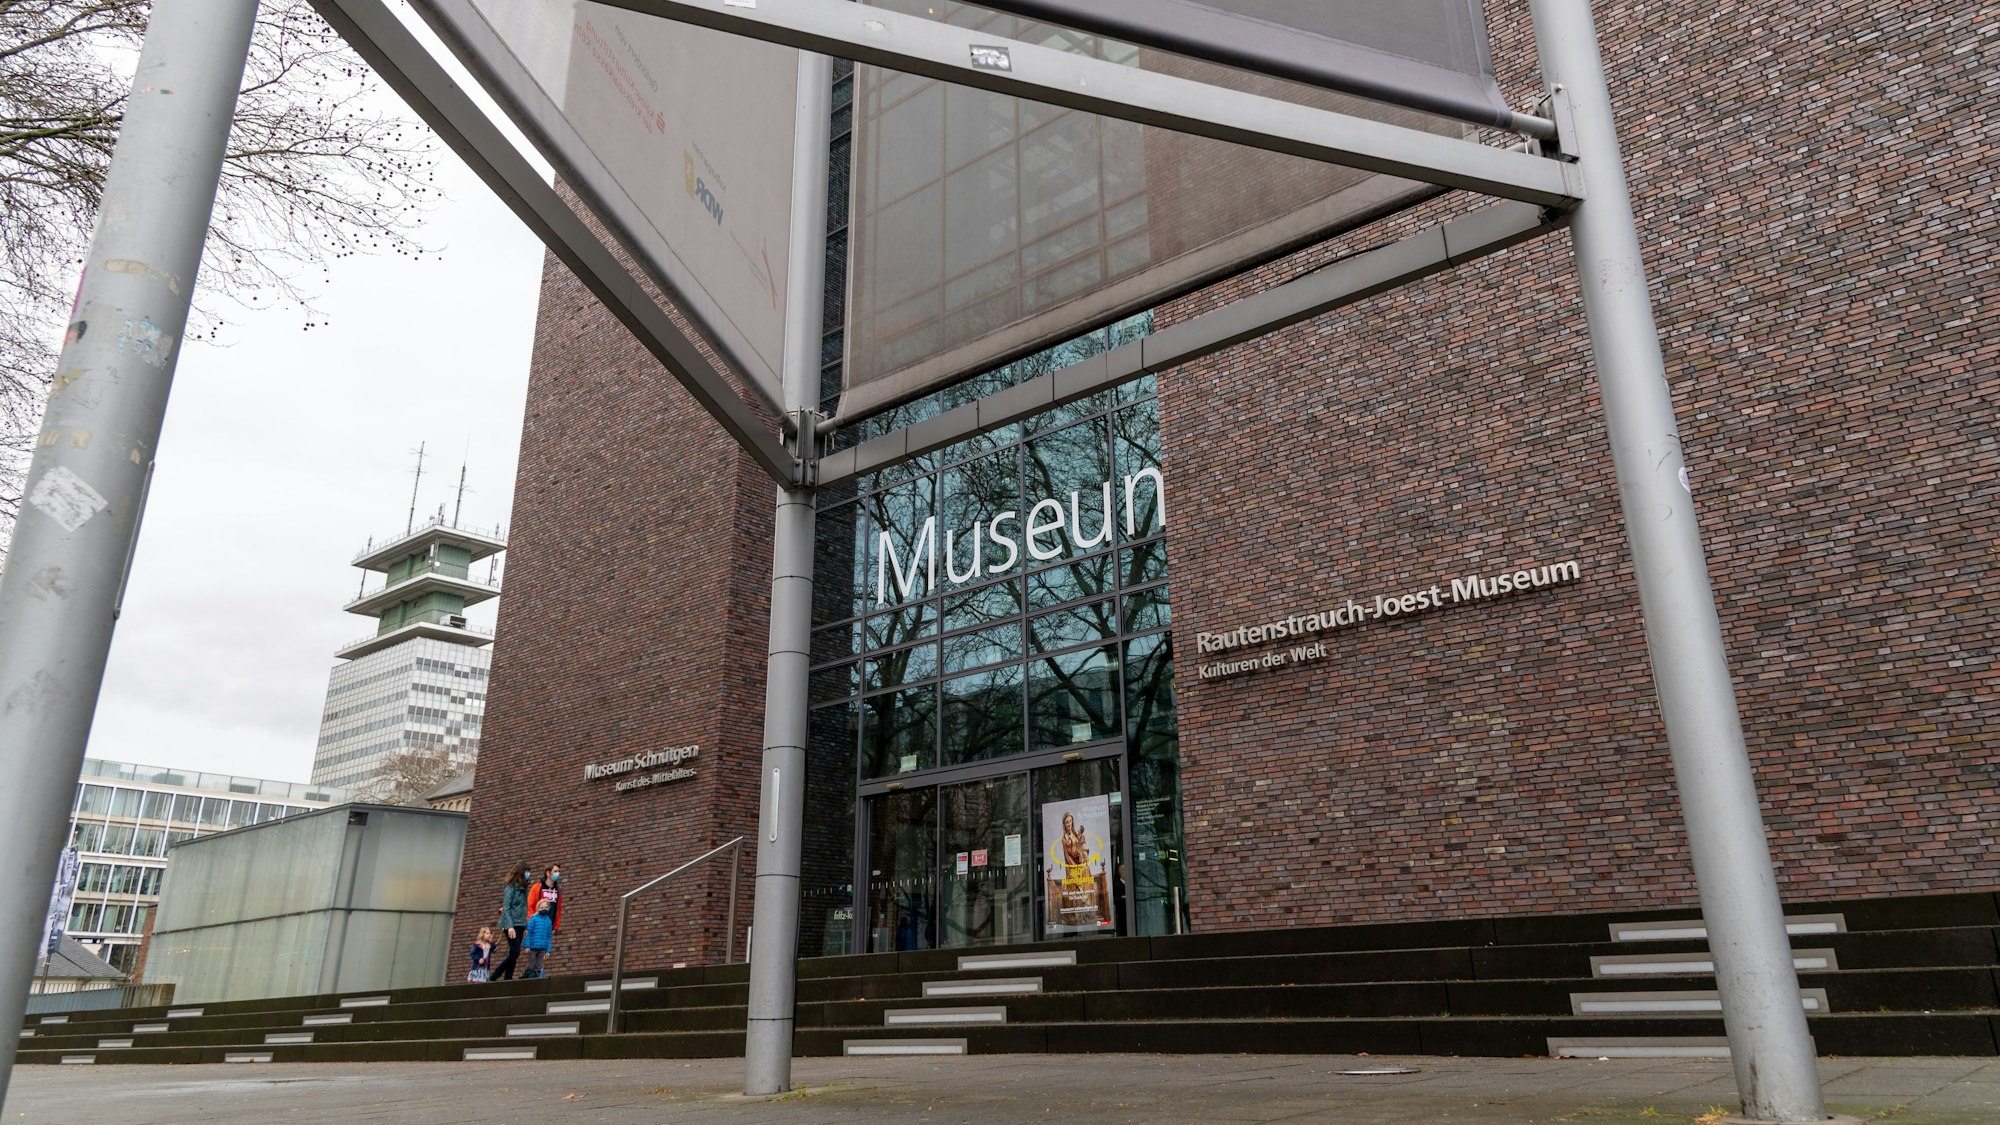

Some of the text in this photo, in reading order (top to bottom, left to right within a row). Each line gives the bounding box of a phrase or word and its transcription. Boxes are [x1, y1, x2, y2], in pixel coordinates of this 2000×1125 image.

[1197, 559, 1580, 653] Rautenstrauch-Joest-Museum
[1198, 642, 1327, 679] Kulturen der Welt
[583, 744, 699, 780] Museum Schnütgen
[615, 779, 637, 791] Kunst
[637, 775, 651, 786] des
[1062, 876, 1094, 886] Rundgang
